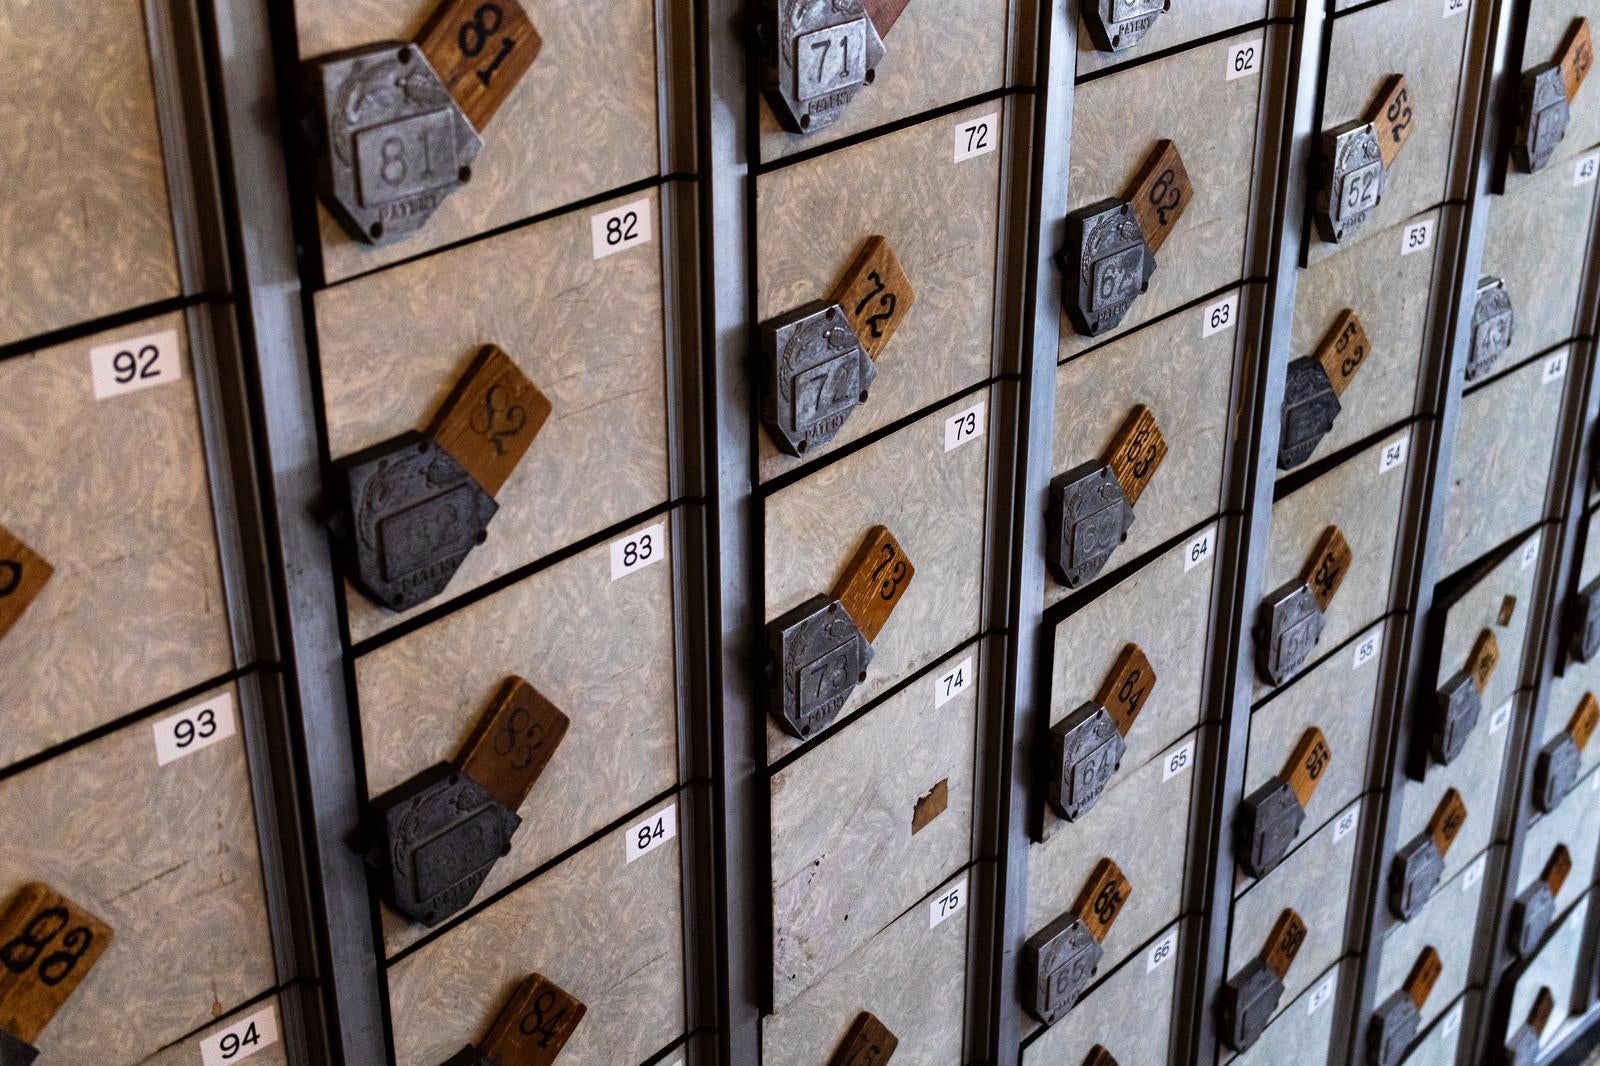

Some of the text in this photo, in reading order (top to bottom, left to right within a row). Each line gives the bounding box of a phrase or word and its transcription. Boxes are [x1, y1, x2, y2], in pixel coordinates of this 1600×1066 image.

[458, 3, 515, 87] 81
[811, 36, 850, 83] 71
[1235, 47, 1254, 72] 62
[1387, 88, 1412, 143] 52
[965, 123, 988, 152] 72
[381, 130, 434, 187] 81
[1150, 169, 1181, 226] 62
[1348, 172, 1375, 207] 52
[606, 211, 639, 246] 82
[1409, 226, 1426, 248] 53
[855, 269, 897, 338] 72
[1210, 303, 1230, 329] 63
[113, 344, 161, 384] 92
[1335, 322, 1364, 377] 53
[954, 412, 976, 441] 73
[1127, 429, 1157, 479] 63
[1386, 445, 1401, 466] 54
[623, 534, 653, 567] 83
[1191, 537, 1208, 562] 64
[872, 543, 907, 601] 73
[1359, 639, 1374, 661] 55
[811, 654, 850, 699] 73
[944, 668, 964, 696] 74
[1117, 669, 1145, 717] 64
[173, 708, 217, 748] 93
[494, 707, 543, 770] 83
[1170, 749, 1188, 773] 65
[1305, 741, 1329, 781] 55
[637, 817, 665, 849] 84
[938, 889, 959, 917] 75
[1153, 940, 1171, 964] 66
[219, 1021, 261, 1060] 94
